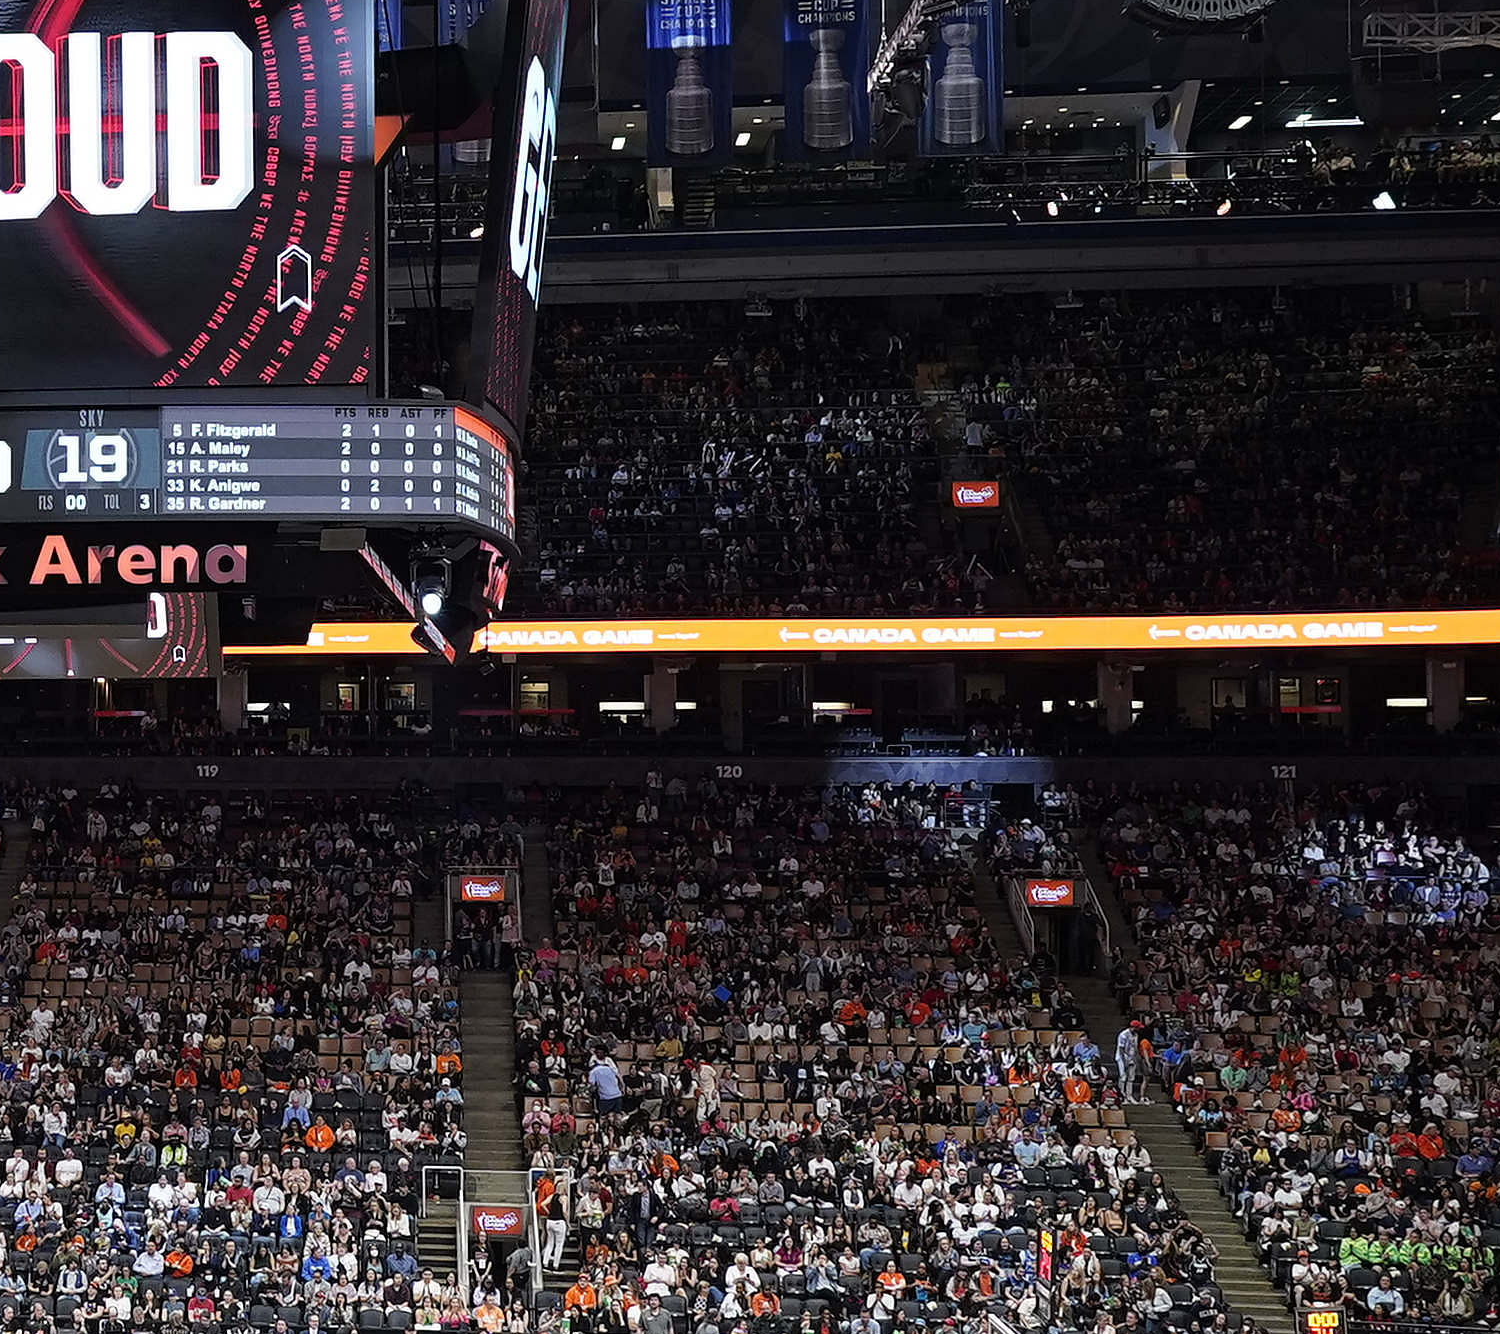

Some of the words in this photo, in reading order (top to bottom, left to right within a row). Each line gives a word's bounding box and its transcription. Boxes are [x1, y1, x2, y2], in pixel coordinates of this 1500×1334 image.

[797, 10, 856, 24] CHAMPIONS
[79, 409, 104, 427] SKY
[173, 424, 182, 436] 5
[191, 424, 203, 436] F.
[206, 423, 276, 439] Fitzgerald
[168, 442, 185, 455] 15
[190, 442, 206, 455] A.
[208, 442, 250, 457] Maley
[58, 435, 127, 483] 19
[167, 460, 183, 473] 21
[190, 460, 204, 473] R.
[208, 460, 249, 473] Parks
[167, 479, 184, 492] 33
[190, 479, 205, 492] K.
[207, 479, 260, 494] Anigwe
[167, 497, 184, 510] 35
[190, 497, 205, 510] R.
[208, 496, 266, 510] Gardner
[29, 534, 248, 586] Arena
[196, 765, 219, 778] 119
[716, 765, 743, 779] 120
